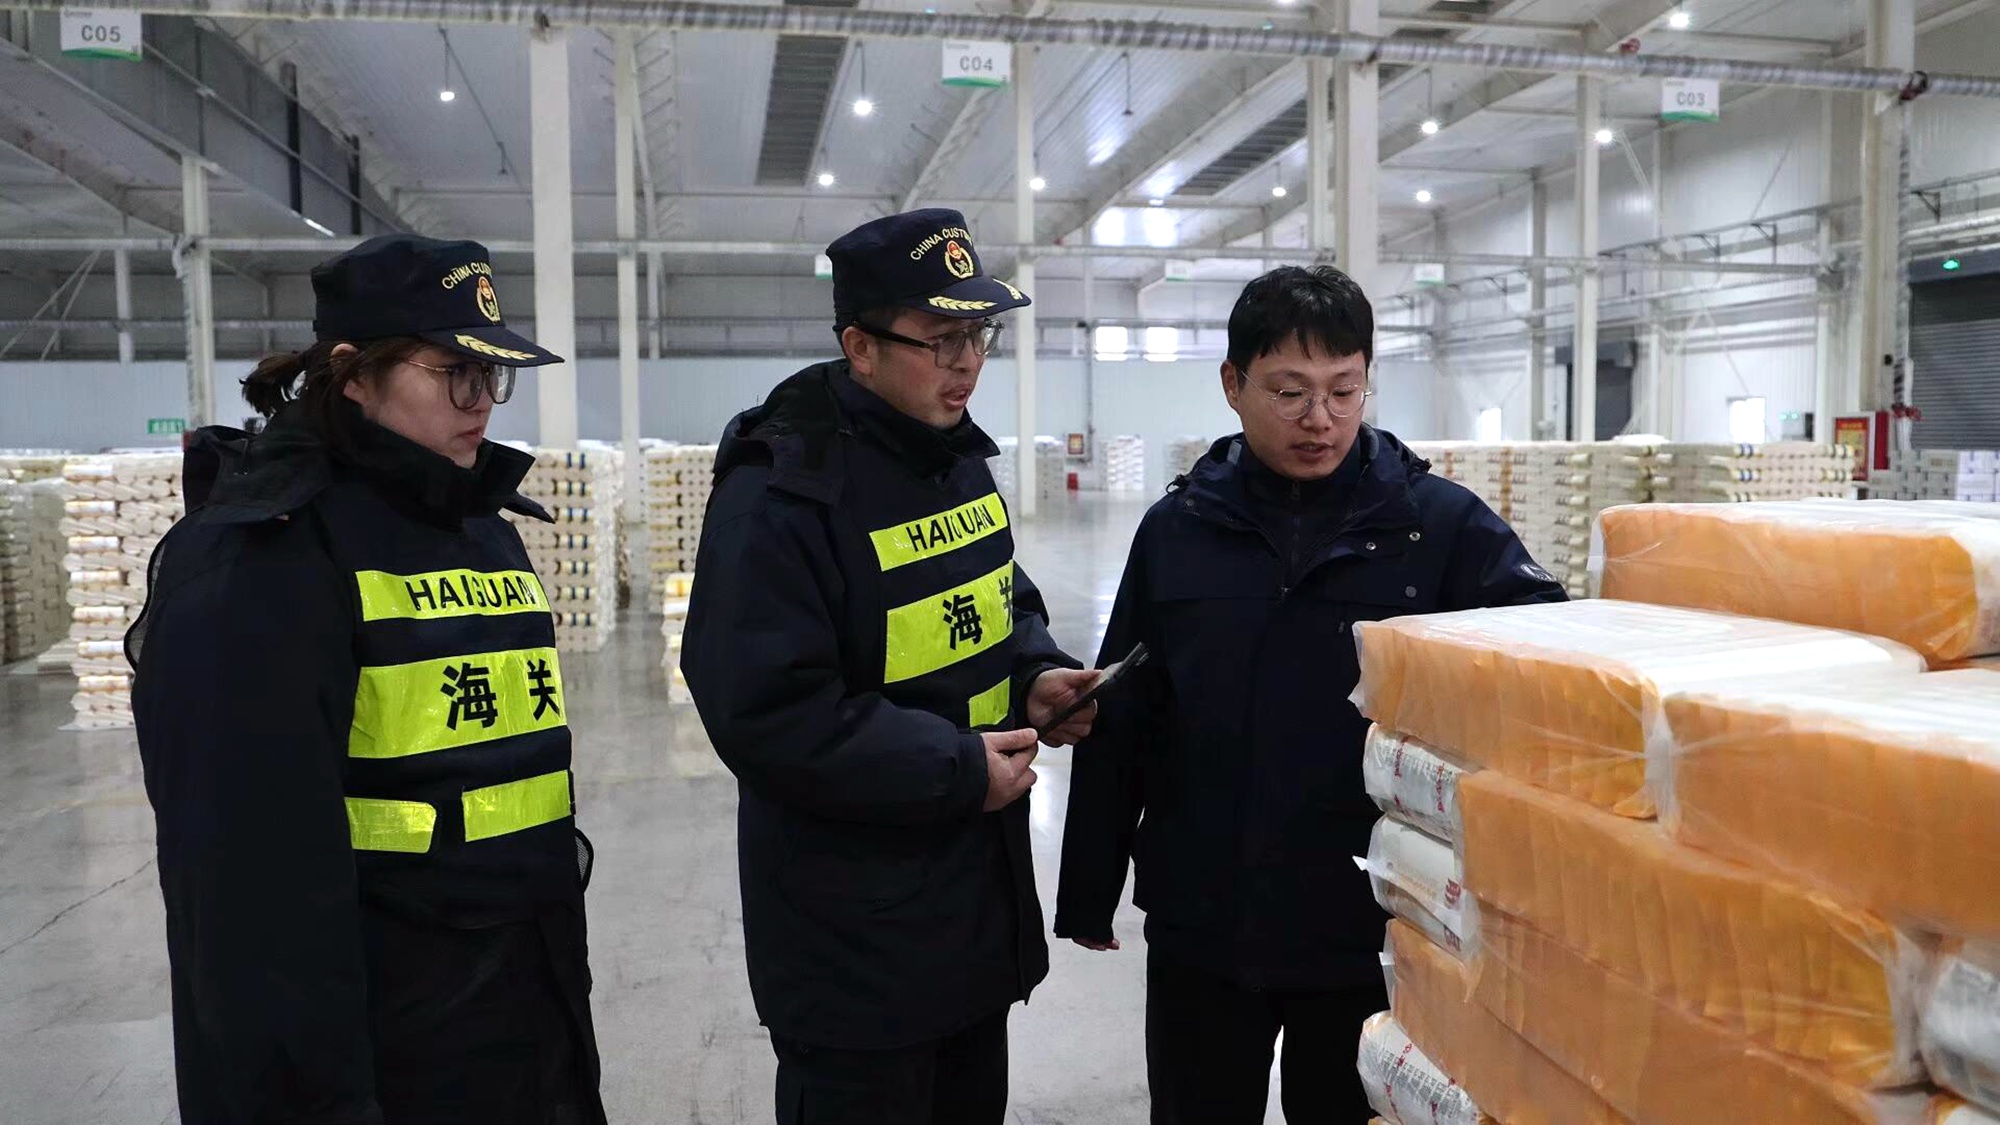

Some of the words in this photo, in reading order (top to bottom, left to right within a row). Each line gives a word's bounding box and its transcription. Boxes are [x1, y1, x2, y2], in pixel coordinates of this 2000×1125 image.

[81, 25, 121, 43] C05
[960, 55, 993, 71] C04
[1677, 91, 1706, 107] C03
[910, 233, 944, 260] CHINA
[441, 264, 474, 290] CHINA
[942, 575, 1014, 651] 海关
[440, 658, 561, 731] 海关
